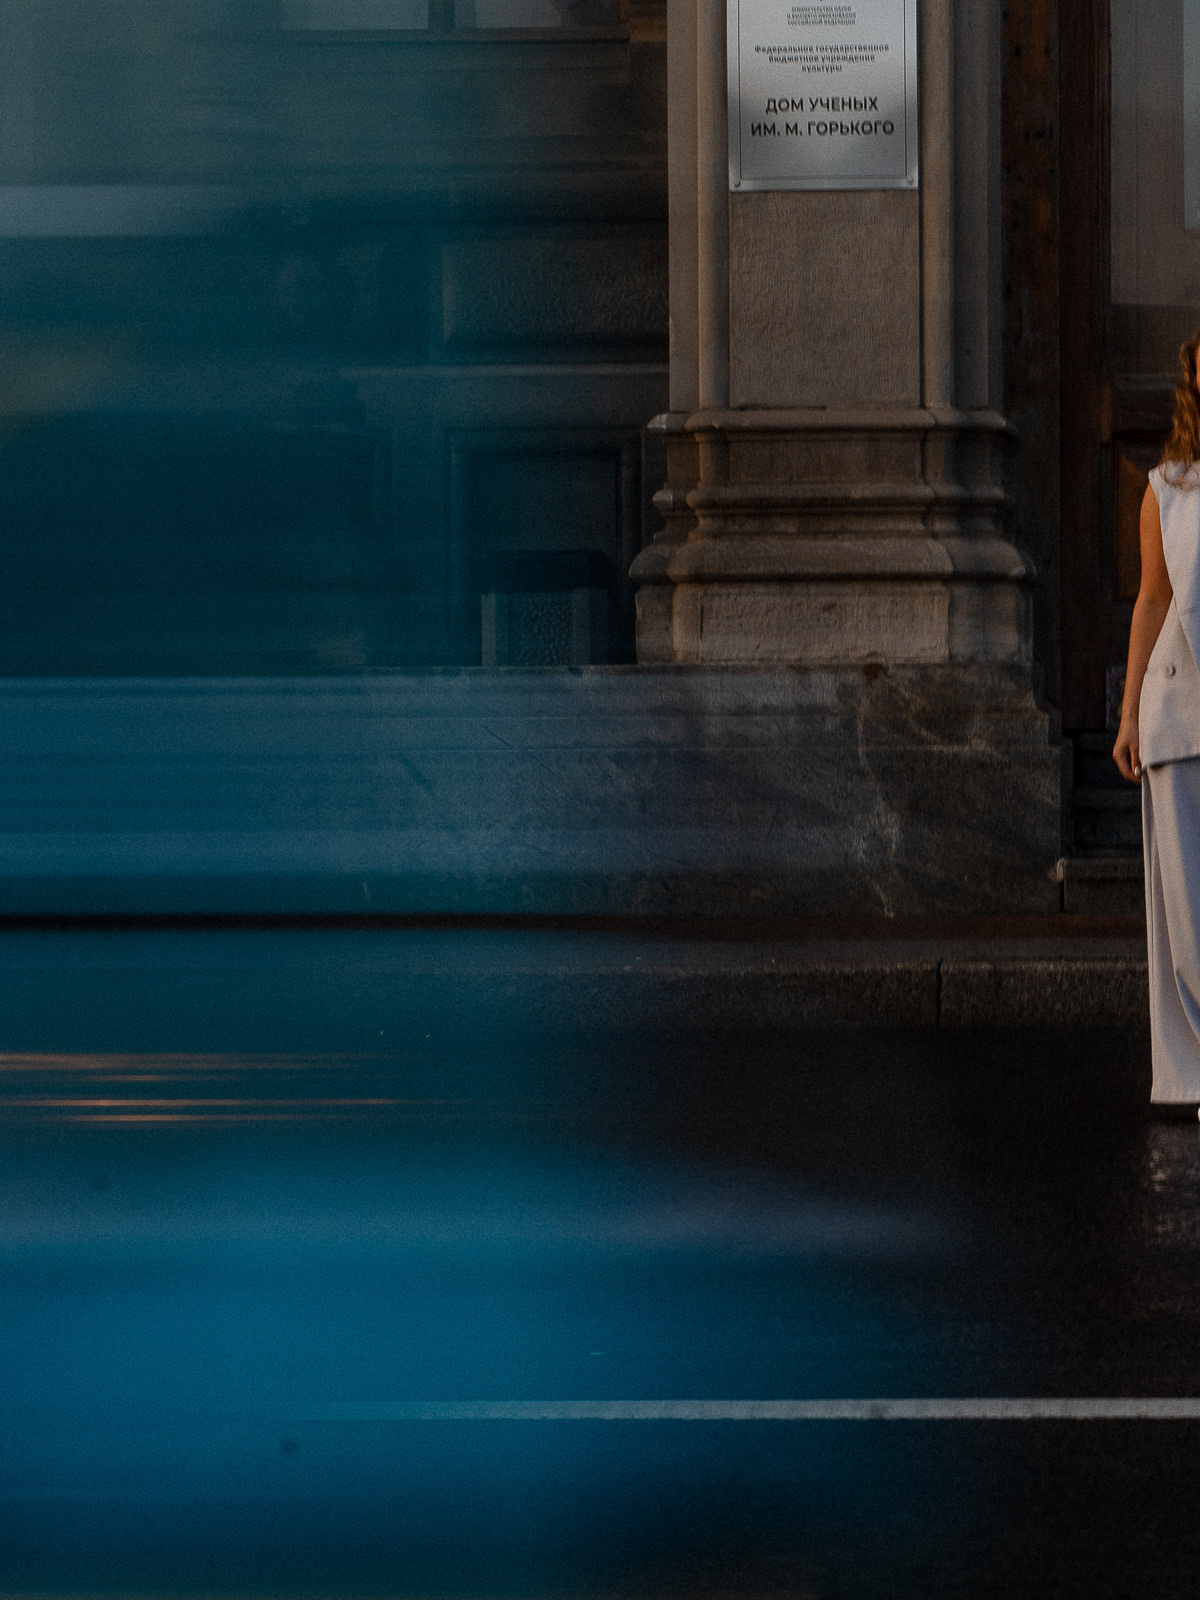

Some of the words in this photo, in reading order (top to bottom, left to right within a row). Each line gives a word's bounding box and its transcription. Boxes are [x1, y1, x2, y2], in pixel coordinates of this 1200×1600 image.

[754, 44, 814, 55] Федеральное
[816, 43, 890, 54] государственное
[821, 54, 876, 64] учреждение
[801, 64, 843, 74] культуры
[765, 97, 804, 115] ДОМ
[808, 96, 879, 112] УЧЕНЫХ
[751, 121, 781, 137] ИМ.
[785, 121, 803, 136] М.
[807, 120, 895, 136] ГОРЬКОГО
